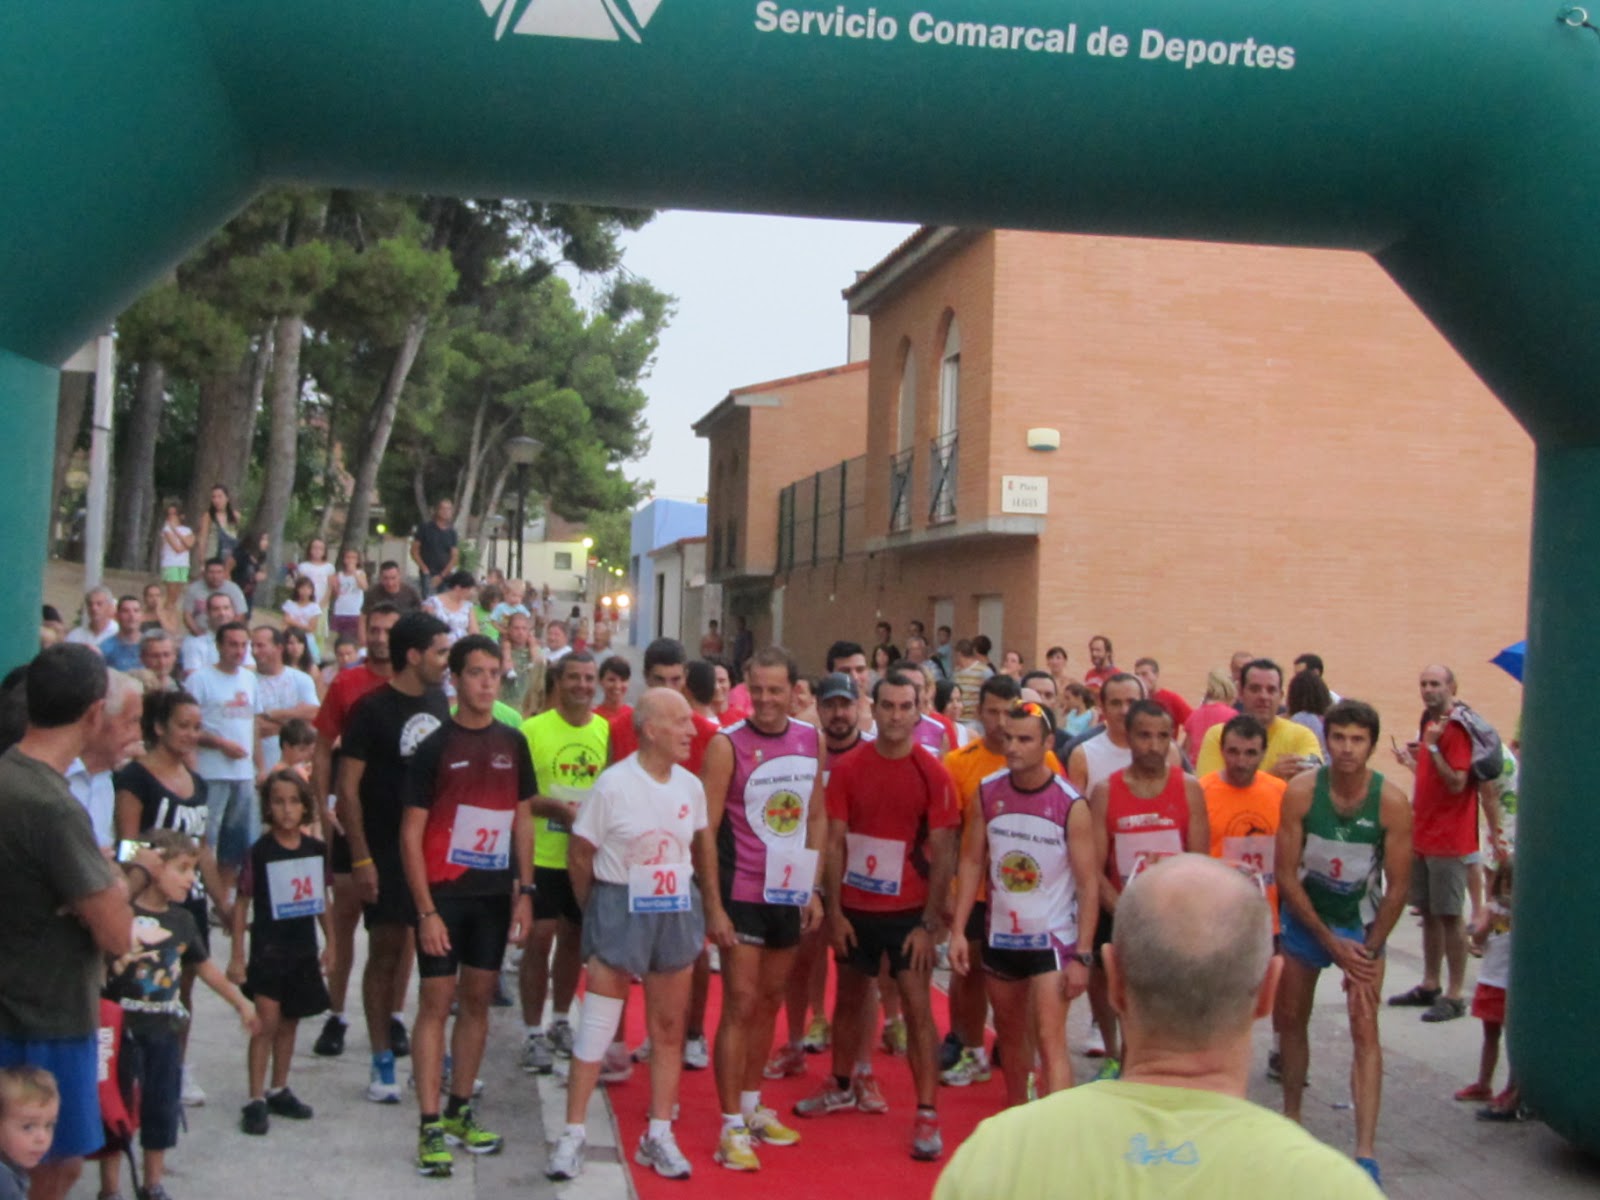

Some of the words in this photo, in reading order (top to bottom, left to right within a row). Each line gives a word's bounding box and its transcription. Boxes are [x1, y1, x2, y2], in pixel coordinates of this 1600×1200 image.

[754, 0, 898, 41] Servicio
[908, 11, 1077, 55] Comarcal
[1086, 26, 1128, 58] de
[1139, 29, 1296, 70] Deportes
[472, 828, 500, 853] 27
[781, 864, 793, 888] 2
[866, 855, 877, 877] 9
[1329, 857, 1343, 878] 3
[290, 875, 313, 901] 24
[653, 871, 677, 895] 20
[1009, 911, 1023, 934] 1
